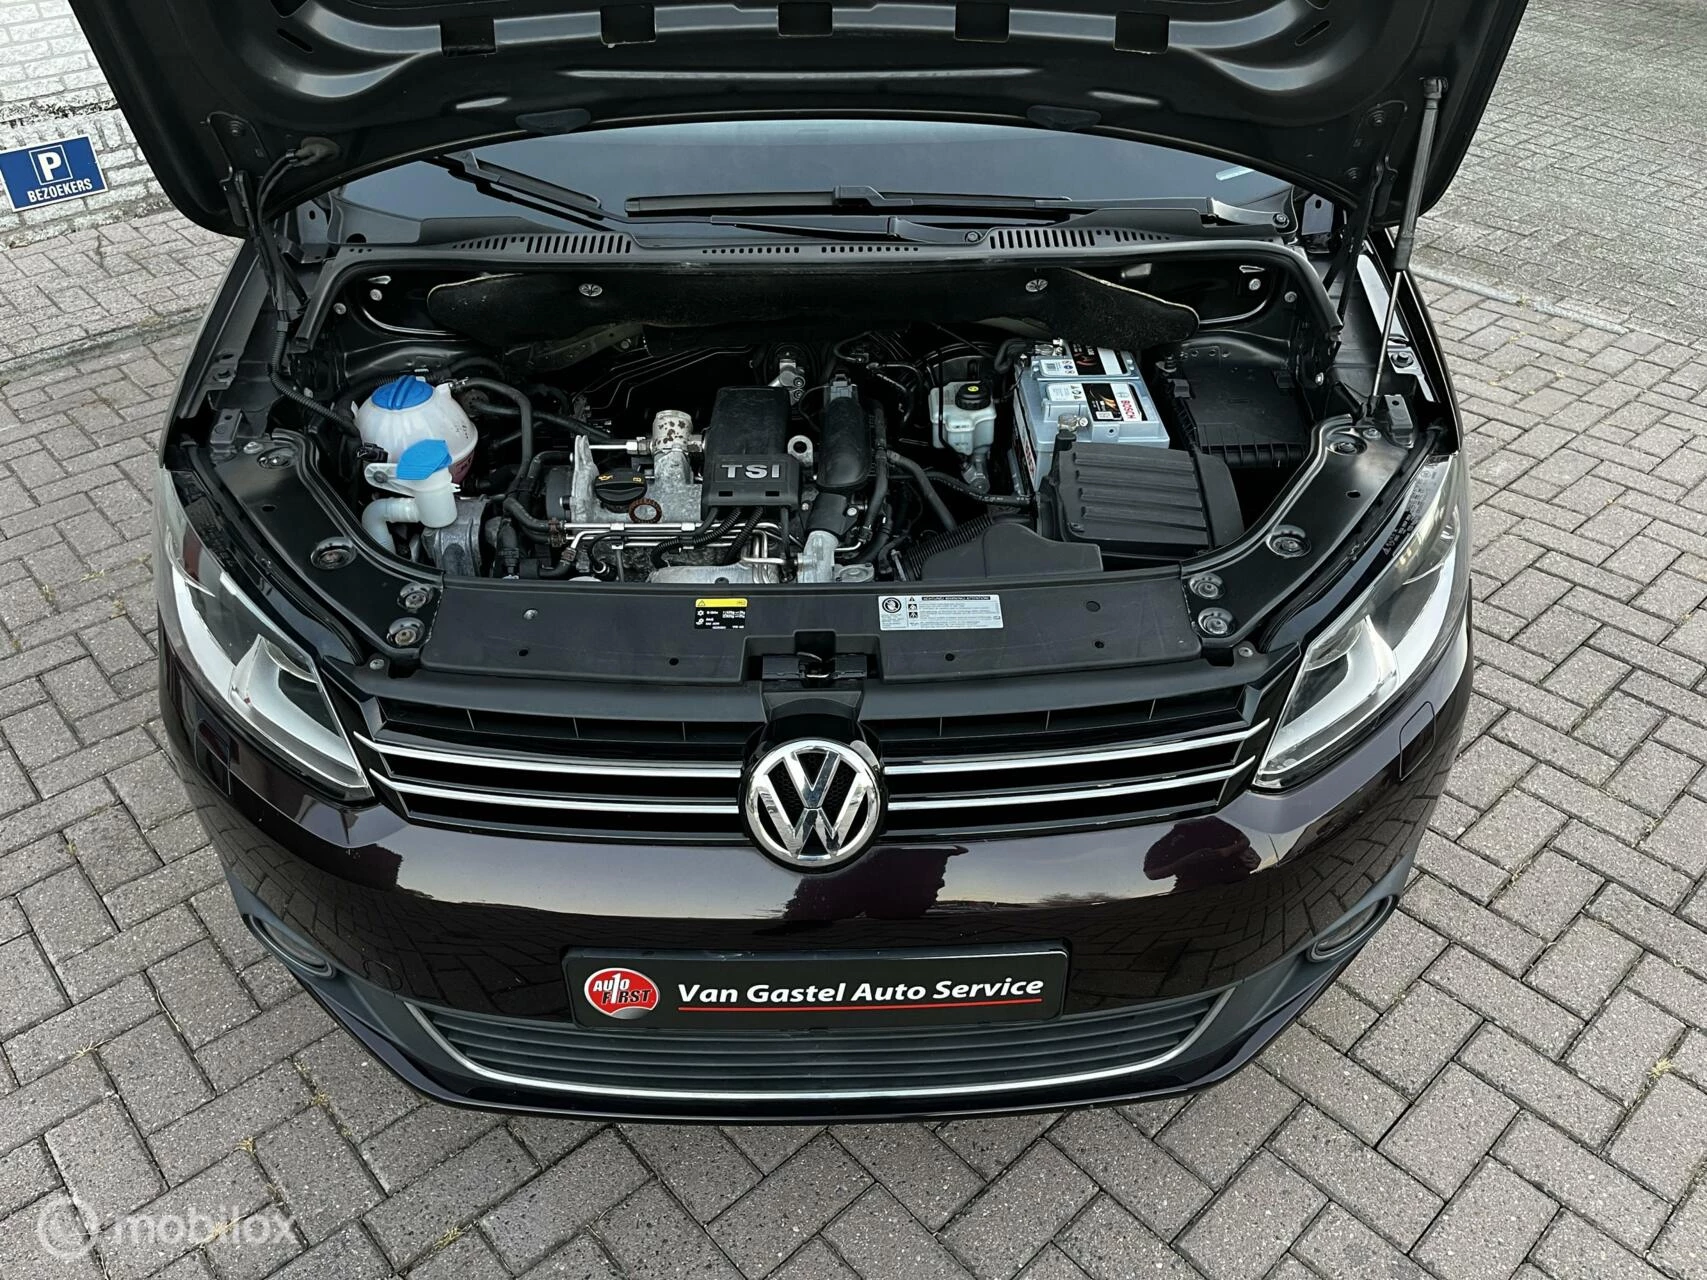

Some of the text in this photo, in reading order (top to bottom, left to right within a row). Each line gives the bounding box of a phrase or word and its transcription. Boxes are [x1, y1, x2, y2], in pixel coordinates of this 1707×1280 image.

[37, 151, 62, 181] P
[27, 178, 93, 203] BEZOEKERS
[721, 464, 780, 479] TSI
[678, 977, 1044, 1003] Van Gastel Auto Service
